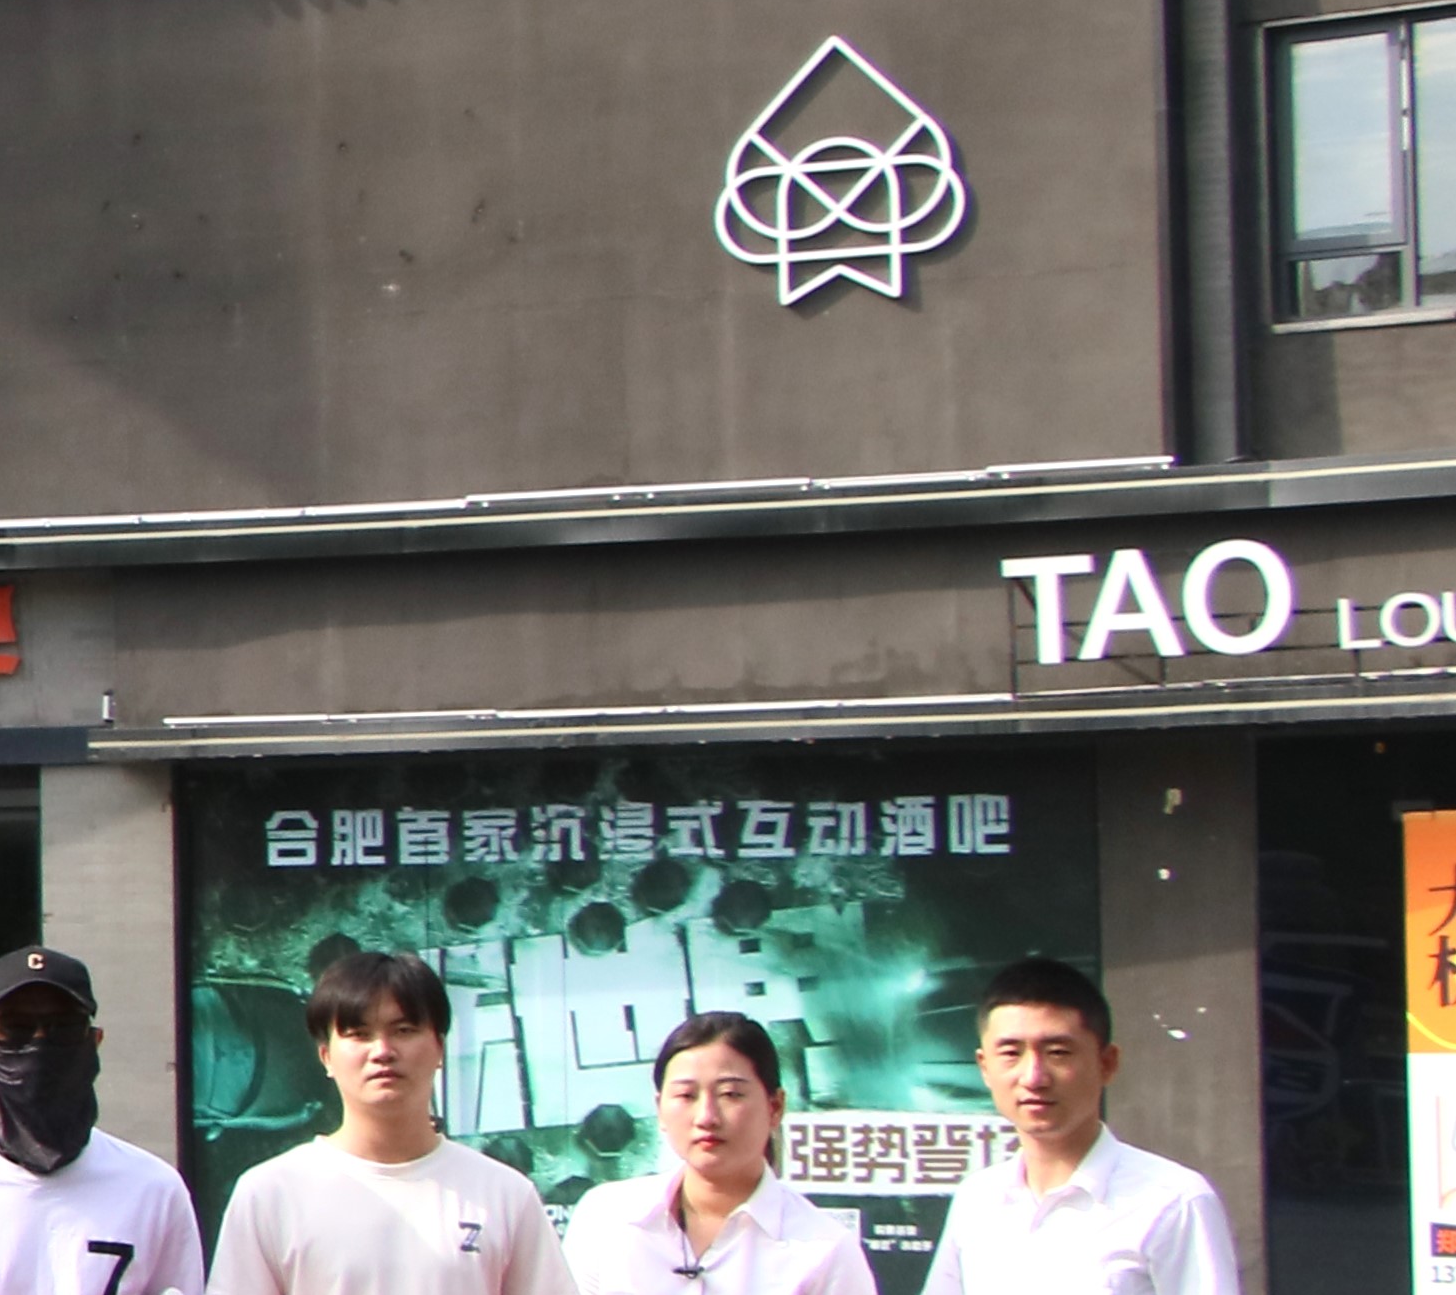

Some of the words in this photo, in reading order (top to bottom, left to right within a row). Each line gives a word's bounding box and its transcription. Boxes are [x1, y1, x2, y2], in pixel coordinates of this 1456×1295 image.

[1000, 538, 1293, 664] TAO
[265, 794, 1011, 867] 合肥首家沉浸式互动酒吧
